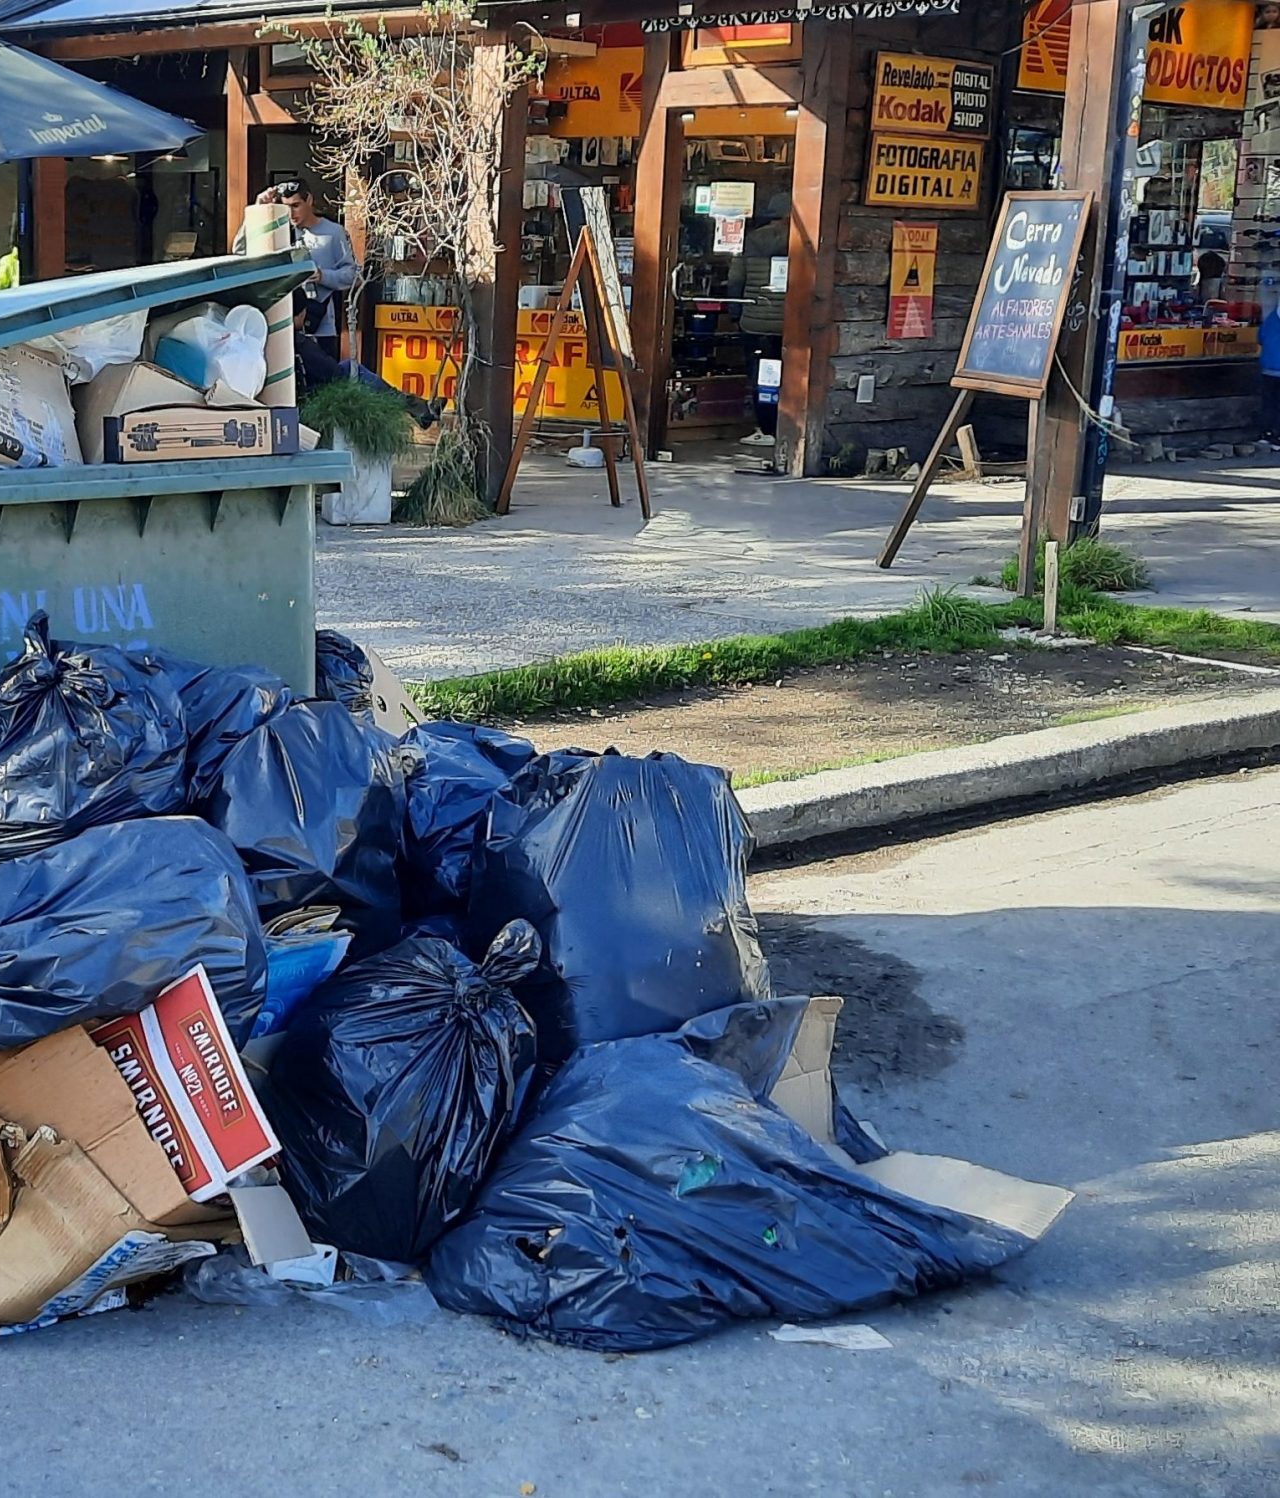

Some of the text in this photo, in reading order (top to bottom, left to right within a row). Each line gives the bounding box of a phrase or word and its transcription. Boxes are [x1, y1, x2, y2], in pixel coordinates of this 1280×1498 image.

[881, 61, 935, 91] Revelado
[954, 71, 991, 90] DIGITAL
[1146, 47, 1244, 95] ODUCTOS
[560, 86, 601, 101] ULTRA
[954, 91, 987, 108] PHOTO
[878, 95, 947, 124] Kodak
[954, 111, 984, 128] SHOP
[26, 113, 107, 145] Imperial
[876, 143, 976, 172] FOTOGRAFIA
[875, 174, 954, 198] DIGITAL
[1006, 211, 1063, 250] Cerro
[994, 253, 1063, 295] Nevado
[390, 311, 419, 323] ULTRA
[550, 312, 580, 325] Kdak
[991, 299, 1055, 318] ALFAJORES
[975, 321, 1053, 340] ARTESANALES
[73, 583, 154, 633] UNA
[188, 1020, 238, 1112] SMIRNOFF
[110, 1043, 184, 1169] SMIRNOFF
